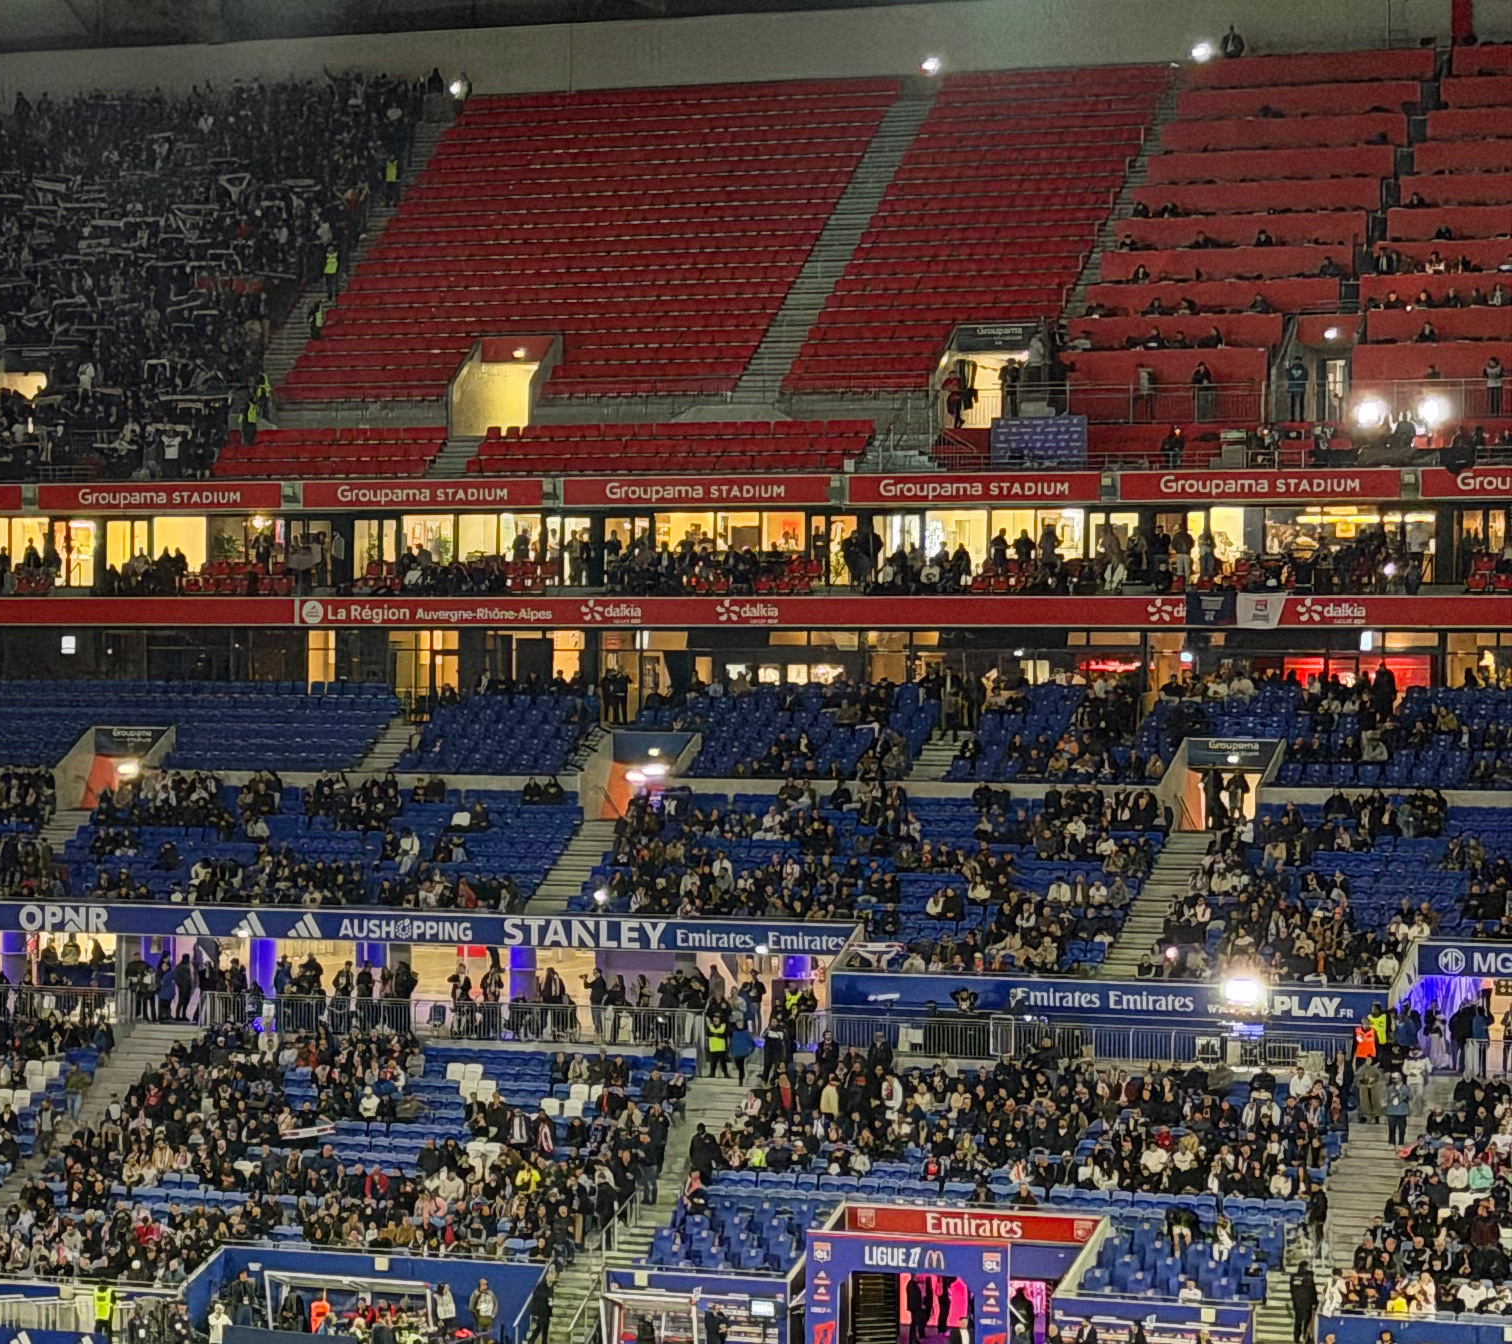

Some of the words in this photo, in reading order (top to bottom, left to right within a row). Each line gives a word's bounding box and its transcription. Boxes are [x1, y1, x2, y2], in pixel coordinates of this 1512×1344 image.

[336, 485, 430, 504] Groupama
[436, 487, 509, 501] STADIUM
[605, 482, 704, 501] Groupama
[709, 484, 786, 499] STADIUM
[879, 479, 983, 500] Groupama
[988, 481, 1069, 496] STADIUM
[1159, 475, 1270, 497] Groupama
[1275, 478, 1361, 493] STADIUM
[78, 488, 167, 506] Groupama
[171, 490, 241, 505] STADIUM
[327, 605, 347, 620] La
[350, 604, 410, 621] Région
[415, 607, 553, 622] Auvergne-Rhône-Alpes
[604, 603, 642, 618] dalkia
[740, 602, 779, 617] dalkia
[1323, 602, 1366, 617] dalkia
[19, 904, 109, 934] OPNR
[503, 919, 666, 949] STANLEY
[676, 929, 754, 949] Emirates
[768, 931, 846, 951] Emirates
[1109, 990, 1194, 1012] Emirates
[926, 1212, 1023, 1238] Emirates
[864, 1246, 906, 1267] LIGUE
